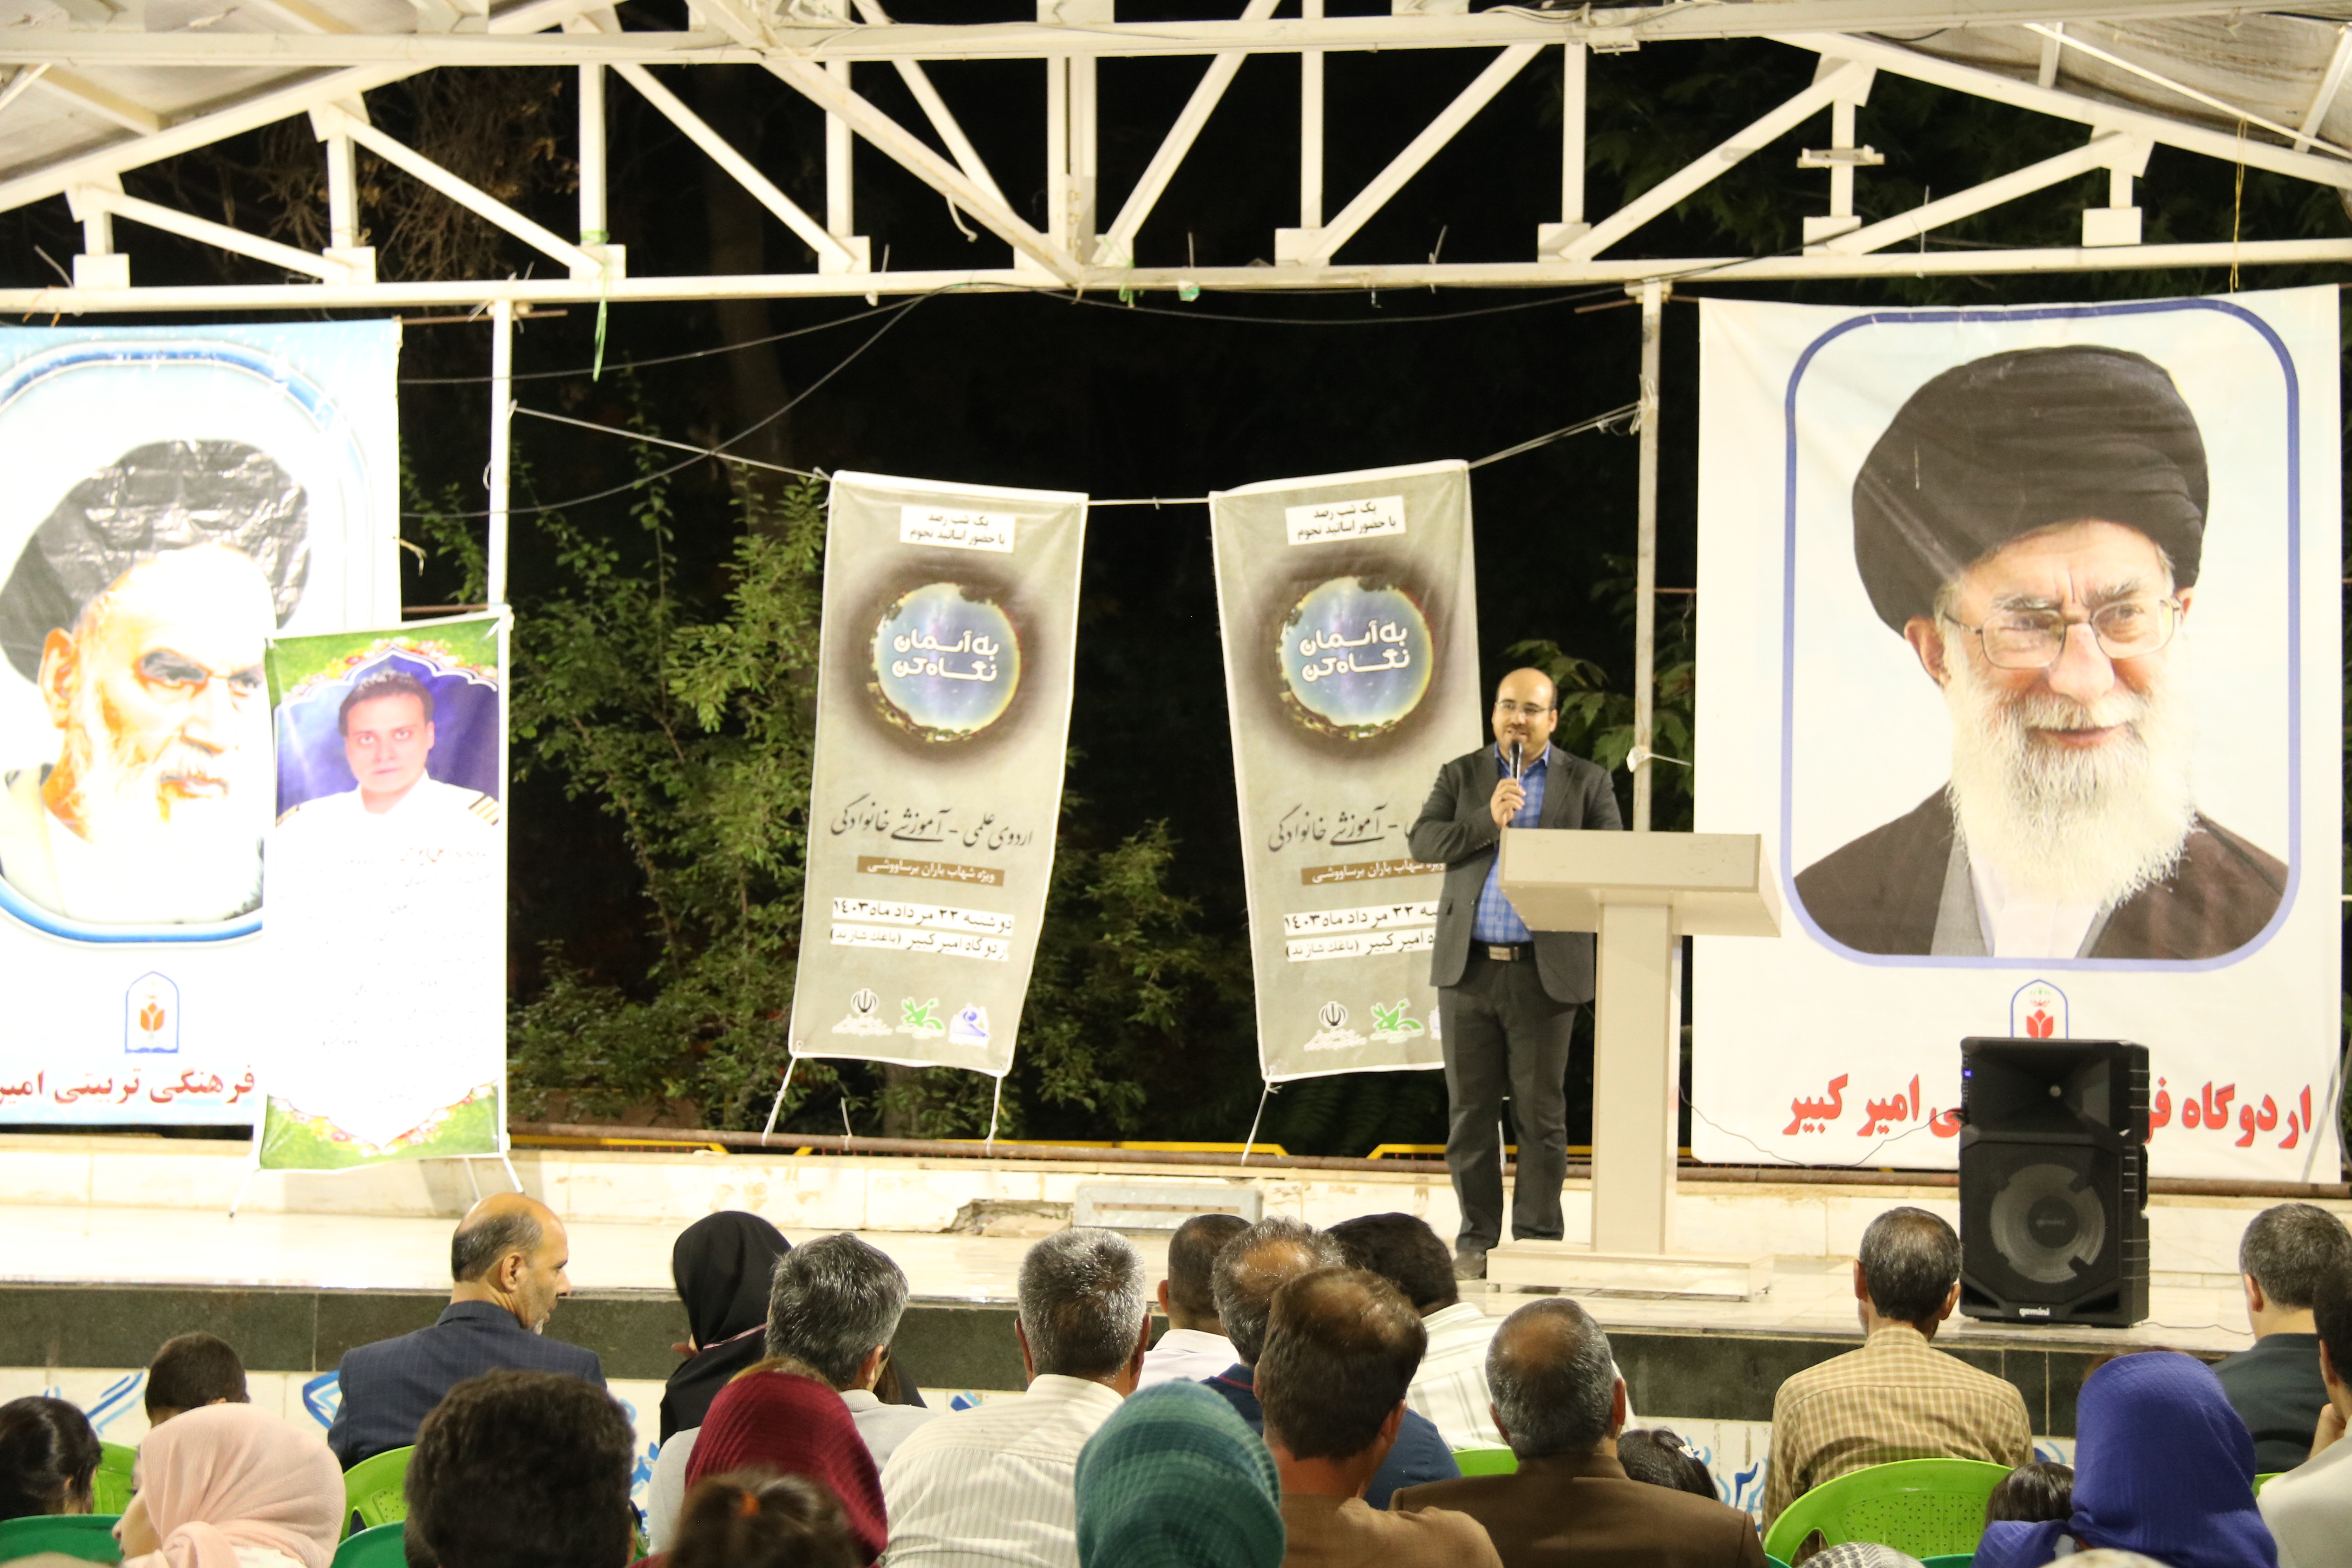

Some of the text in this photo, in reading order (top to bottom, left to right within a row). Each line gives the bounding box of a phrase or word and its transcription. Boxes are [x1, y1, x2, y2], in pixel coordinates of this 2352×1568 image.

[1314, 509, 1334, 520] رصد
[1360, 501, 1376, 515] یک
[974, 515, 989, 528] یک
[1358, 519, 1385, 534] حضور
[968, 535, 994, 545] حضور
[1298, 525, 1321, 540] نجوم
[893, 628, 999, 662] به آسمان
[1299, 619, 1408, 657] به آسمان
[891, 656, 998, 682] نگاه کن
[1302, 648, 1410, 682] نگاه کن
[963, 811, 995, 847] علمی
[921, 862, 945, 877] باران
[946, 865, 975, 880] شهاب
[977, 869, 995, 883] ویژه
[1367, 860, 1391, 878] باران
[906, 933, 935, 950] کبیر
[937, 937, 962, 952] امیر
[1366, 932, 1393, 955] کبیر
[1397, 930, 1423, 952] امیر
[54, 1068, 141, 1104] تربیتی
[151, 1064, 254, 1103] فرهنگی
[1782, 1073, 1848, 1135] کبیر
[1857, 1073, 1920, 1137] امیر
[2183, 1081, 2311, 1149] اردوگاه
[2018, 1306, 2050, 1318] gemini
